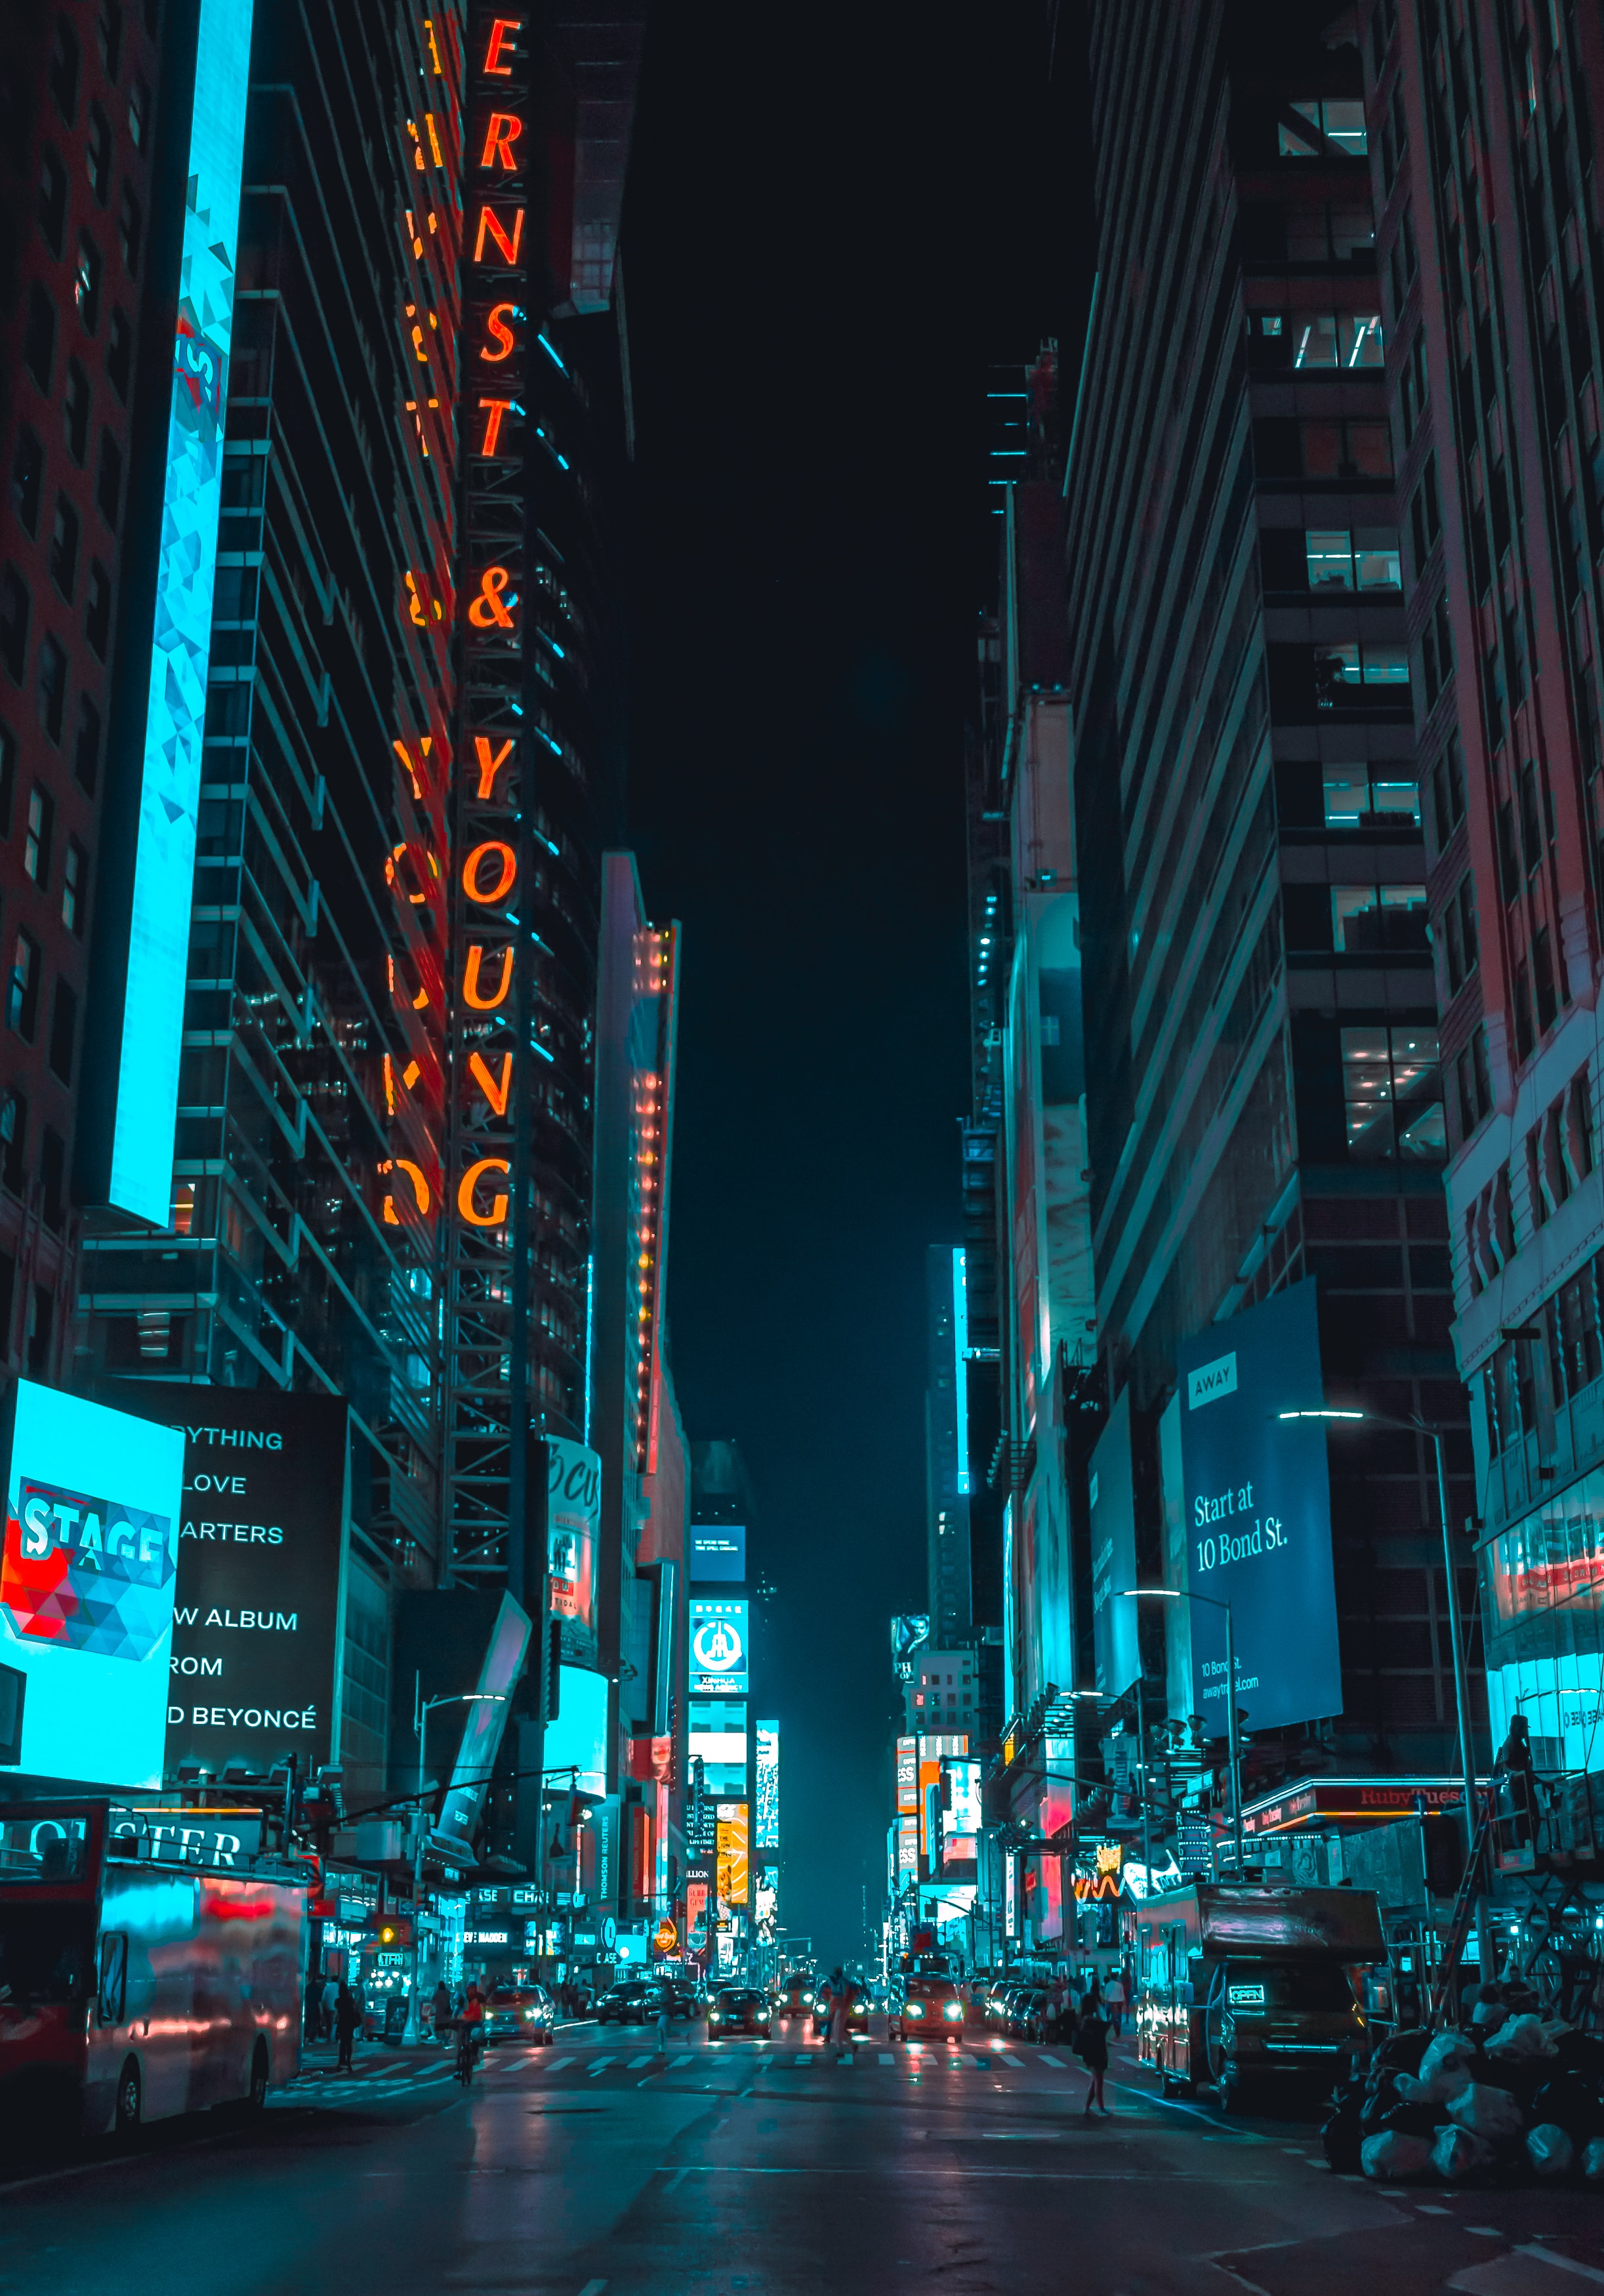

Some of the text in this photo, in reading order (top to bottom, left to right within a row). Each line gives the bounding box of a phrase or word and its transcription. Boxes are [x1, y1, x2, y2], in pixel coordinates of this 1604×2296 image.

[457, 18, 524, 1226] ERNST & YOUNG
[1195, 1366, 1229, 1397] AWAY
[167, 1425, 283, 1450] YTHING
[1195, 1481, 1254, 1527] Start at
[25, 1498, 164, 1570] STAGE
[180, 1521, 283, 1544] ARTERS
[1197, 1517, 1288, 1572] 10 Bond St.
[205, 1609, 298, 1631] ALBUM
[169, 1657, 222, 1675] ROM
[894, 1662, 912, 1673] PH
[1202, 1663, 1210, 1677] 10
[1203, 1676, 1259, 1699] awaytrel.com
[193, 1704, 317, 1729] BEYONCÉ
[1361, 1788, 1412, 1808] Ruby
[688, 1888, 705, 1896] BUBB
[596, 1952, 617, 1964] CASE
[1232, 1990, 1262, 2001] OPEN
